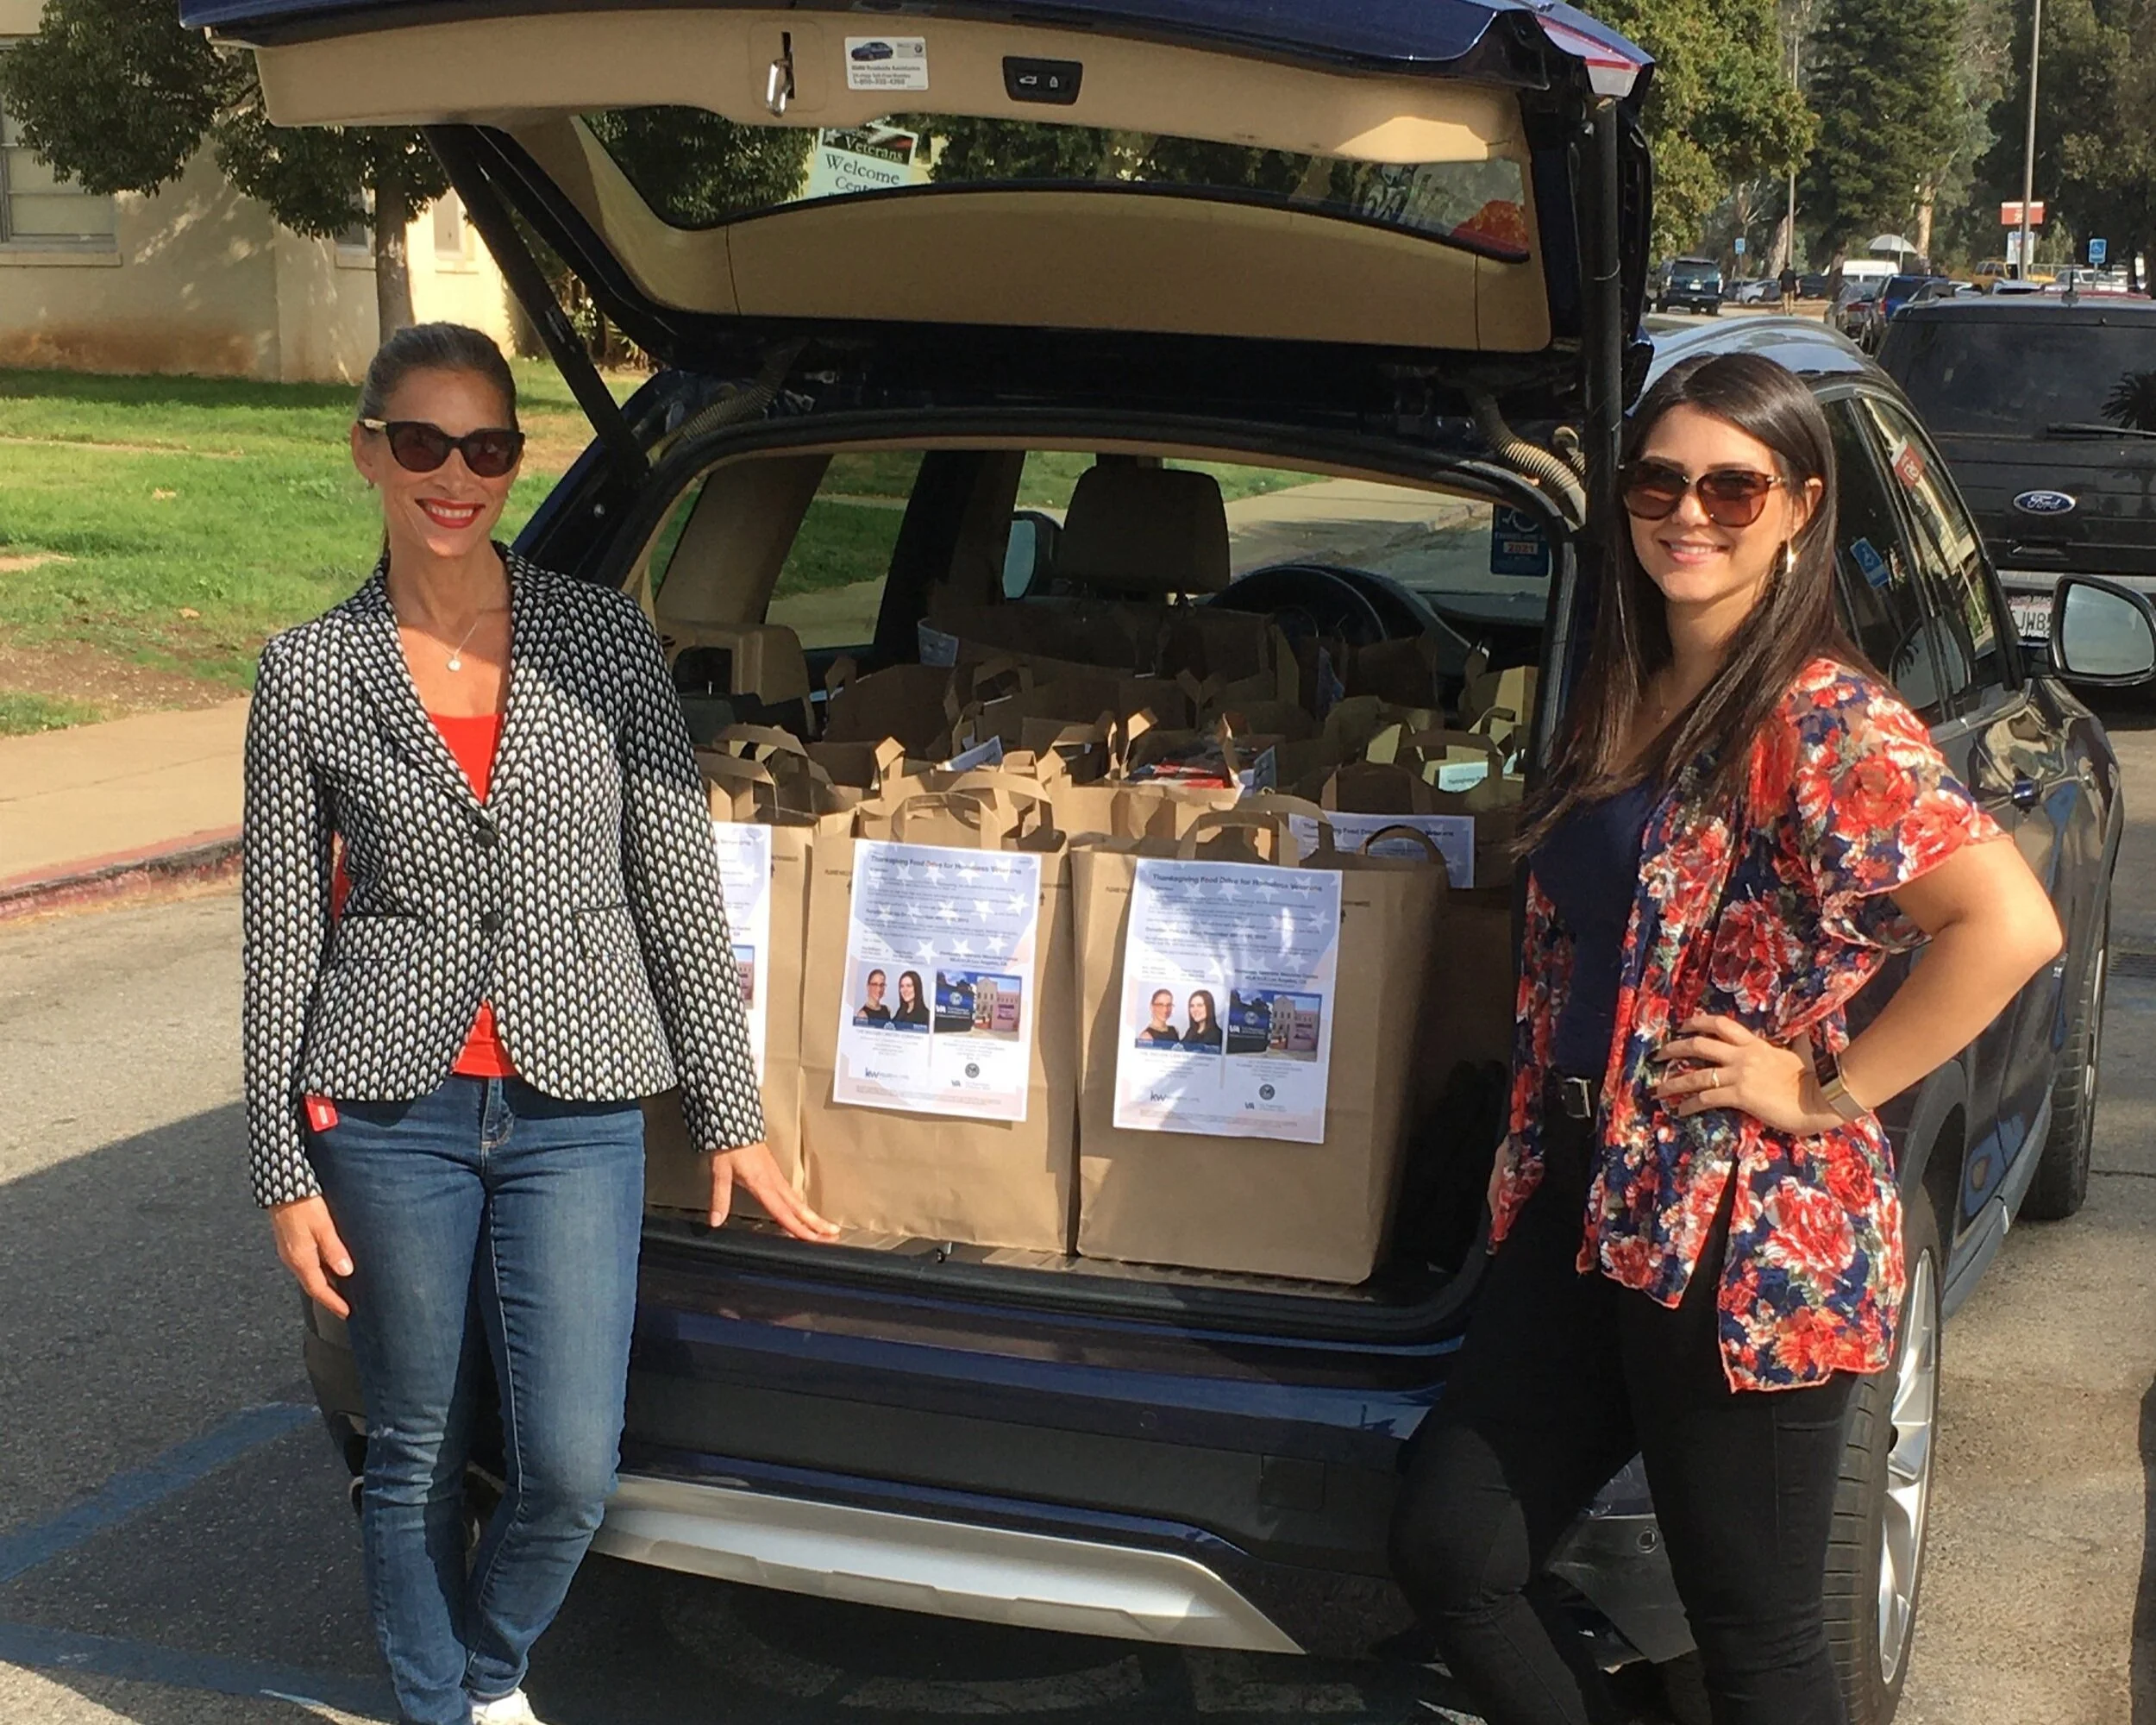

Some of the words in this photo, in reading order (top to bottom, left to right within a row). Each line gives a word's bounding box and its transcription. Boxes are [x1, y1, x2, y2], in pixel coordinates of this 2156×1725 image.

[844, 135, 904, 162] Veterans
[825, 153, 900, 185] Welcome
[2027, 494, 2060, 510] Ford
[1153, 873, 1199, 884] Thanksgiving
[865, 1067, 880, 1079] kw
[1150, 1090, 1166, 1102] kw
